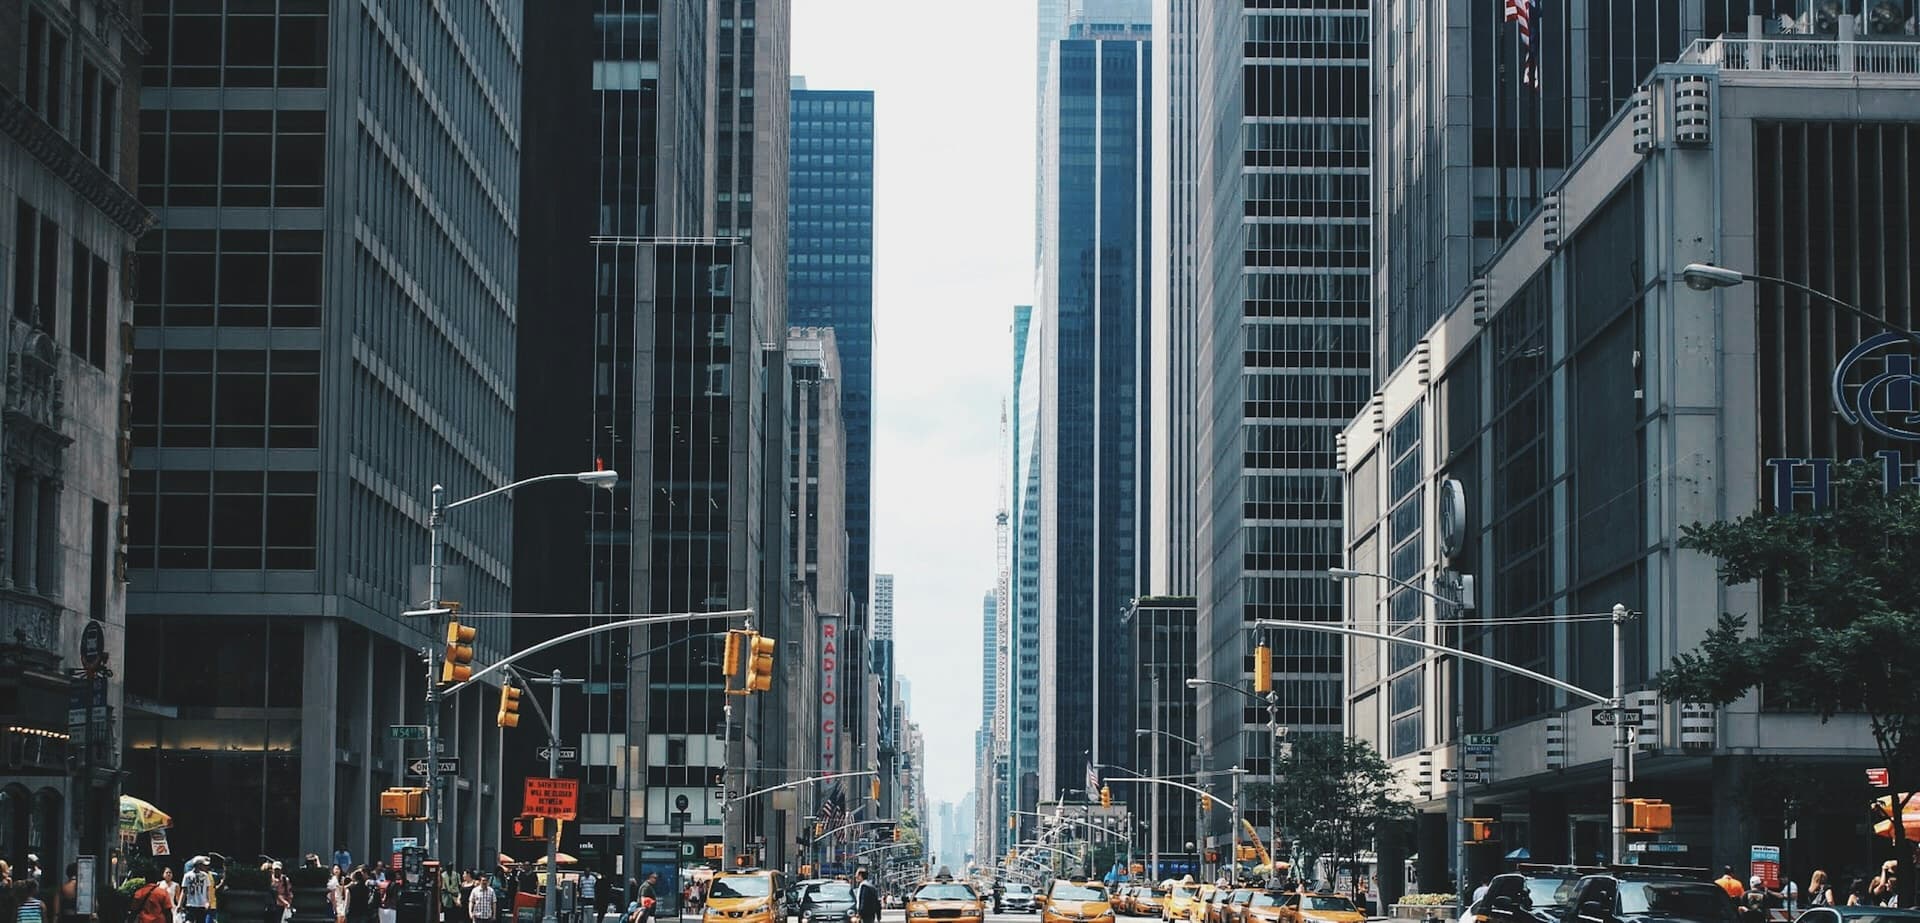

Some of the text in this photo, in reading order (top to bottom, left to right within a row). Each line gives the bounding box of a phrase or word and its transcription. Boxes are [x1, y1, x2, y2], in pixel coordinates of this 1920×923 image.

[823, 624, 835, 784] RADIO CITY
[400, 728, 410, 738] 54
[1481, 736, 1491, 744] 54
